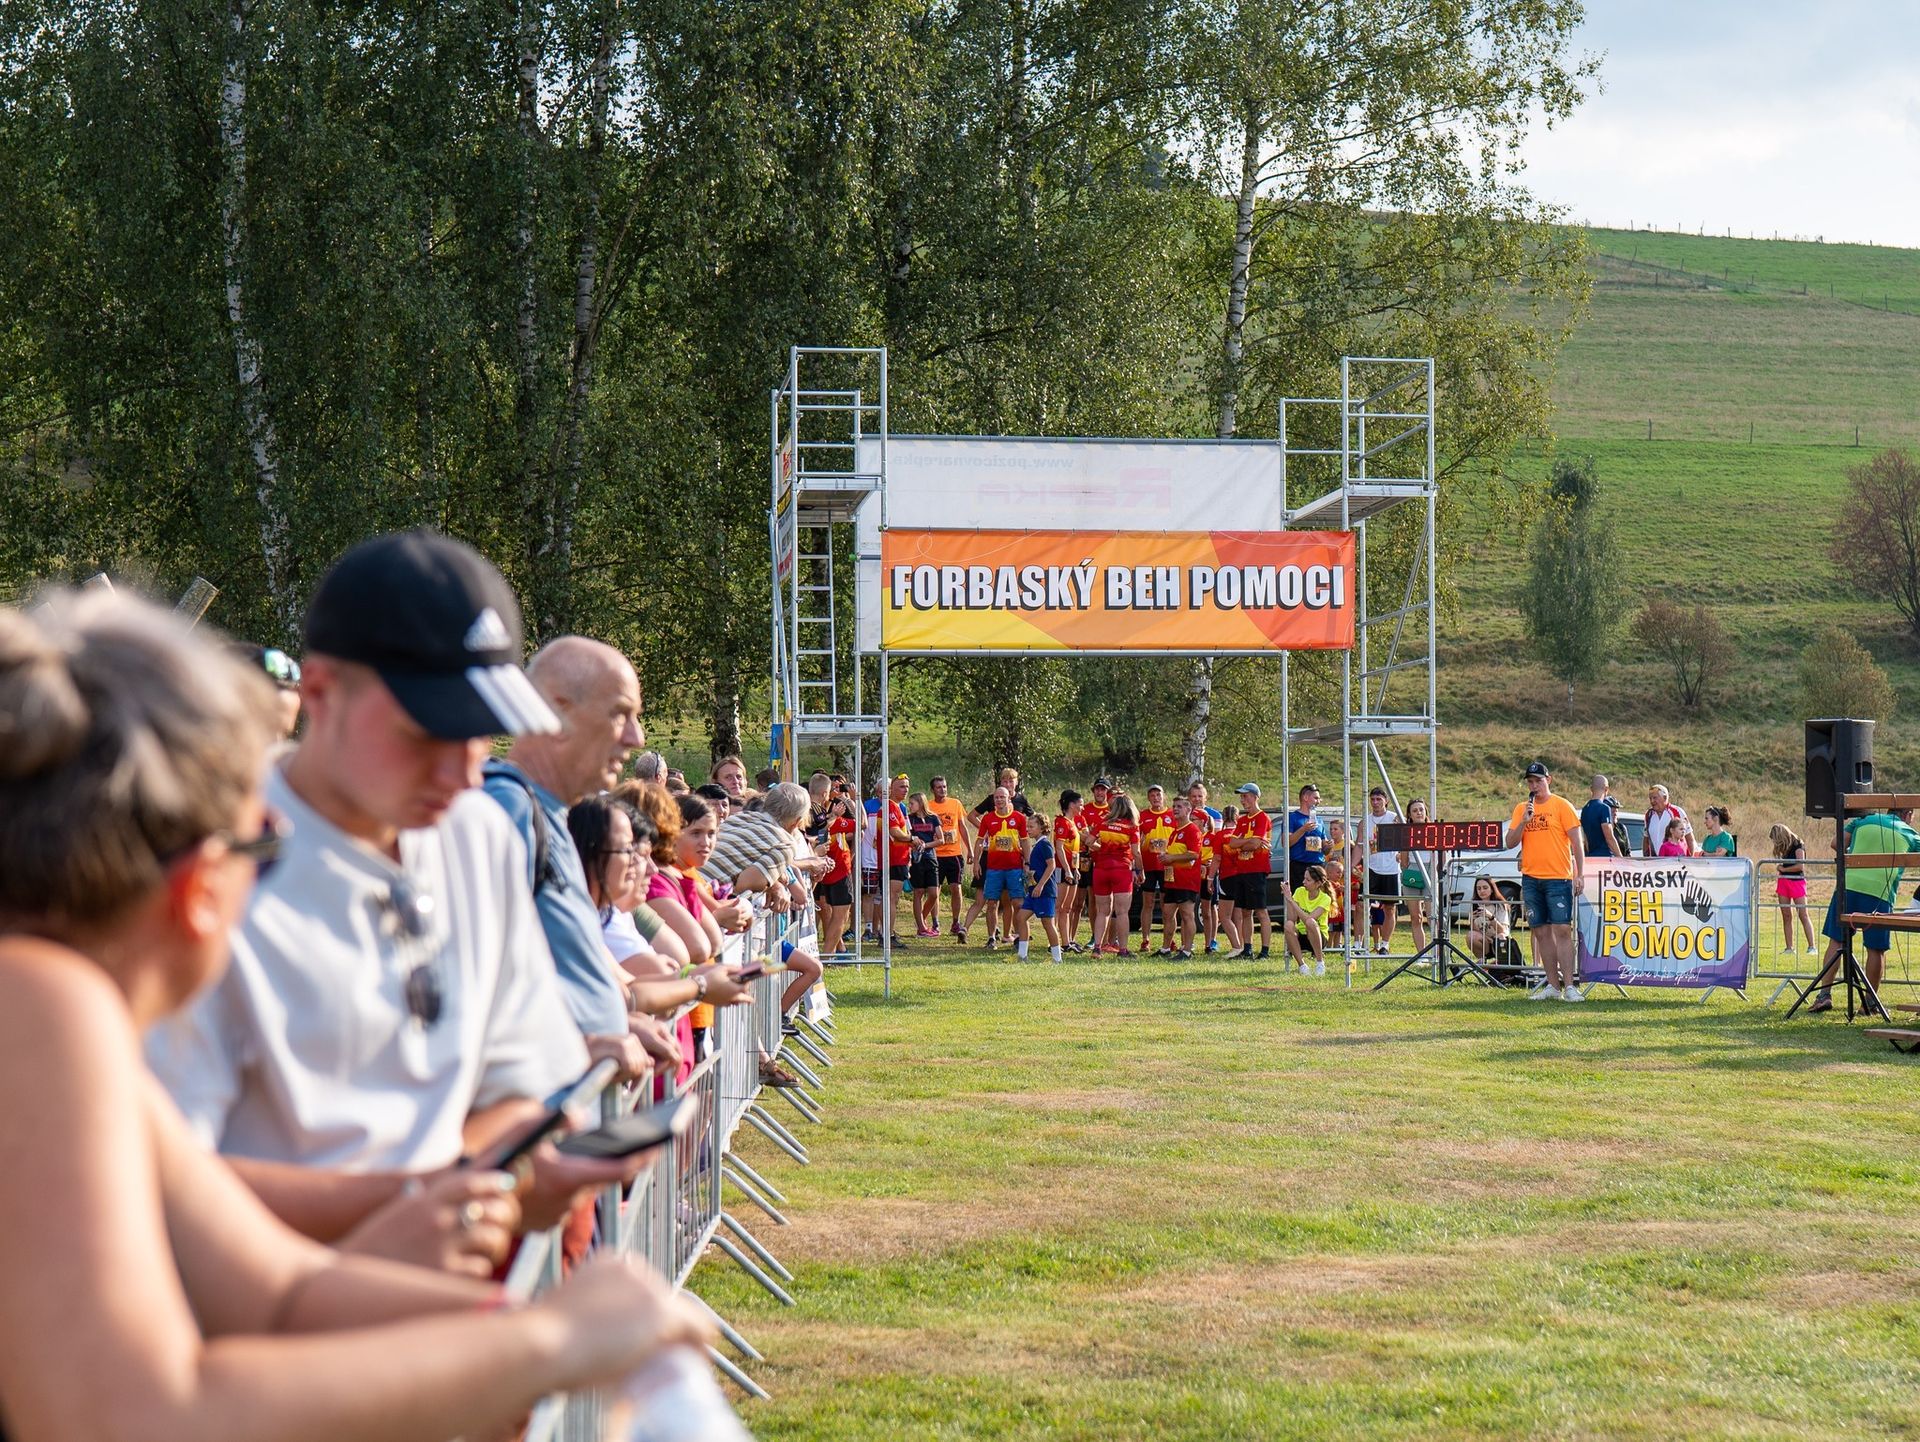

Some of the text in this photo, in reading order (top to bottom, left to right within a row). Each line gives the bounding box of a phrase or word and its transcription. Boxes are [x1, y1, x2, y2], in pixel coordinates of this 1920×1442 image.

[891, 557, 1345, 610] FORBASKÝ BEH POMOCI
[1409, 823, 1499, 848] 1:00:08
[1603, 865, 1688, 889] FORBASKÝ
[1603, 890, 1664, 924] BEH
[1602, 924, 1726, 961] POMOCI
